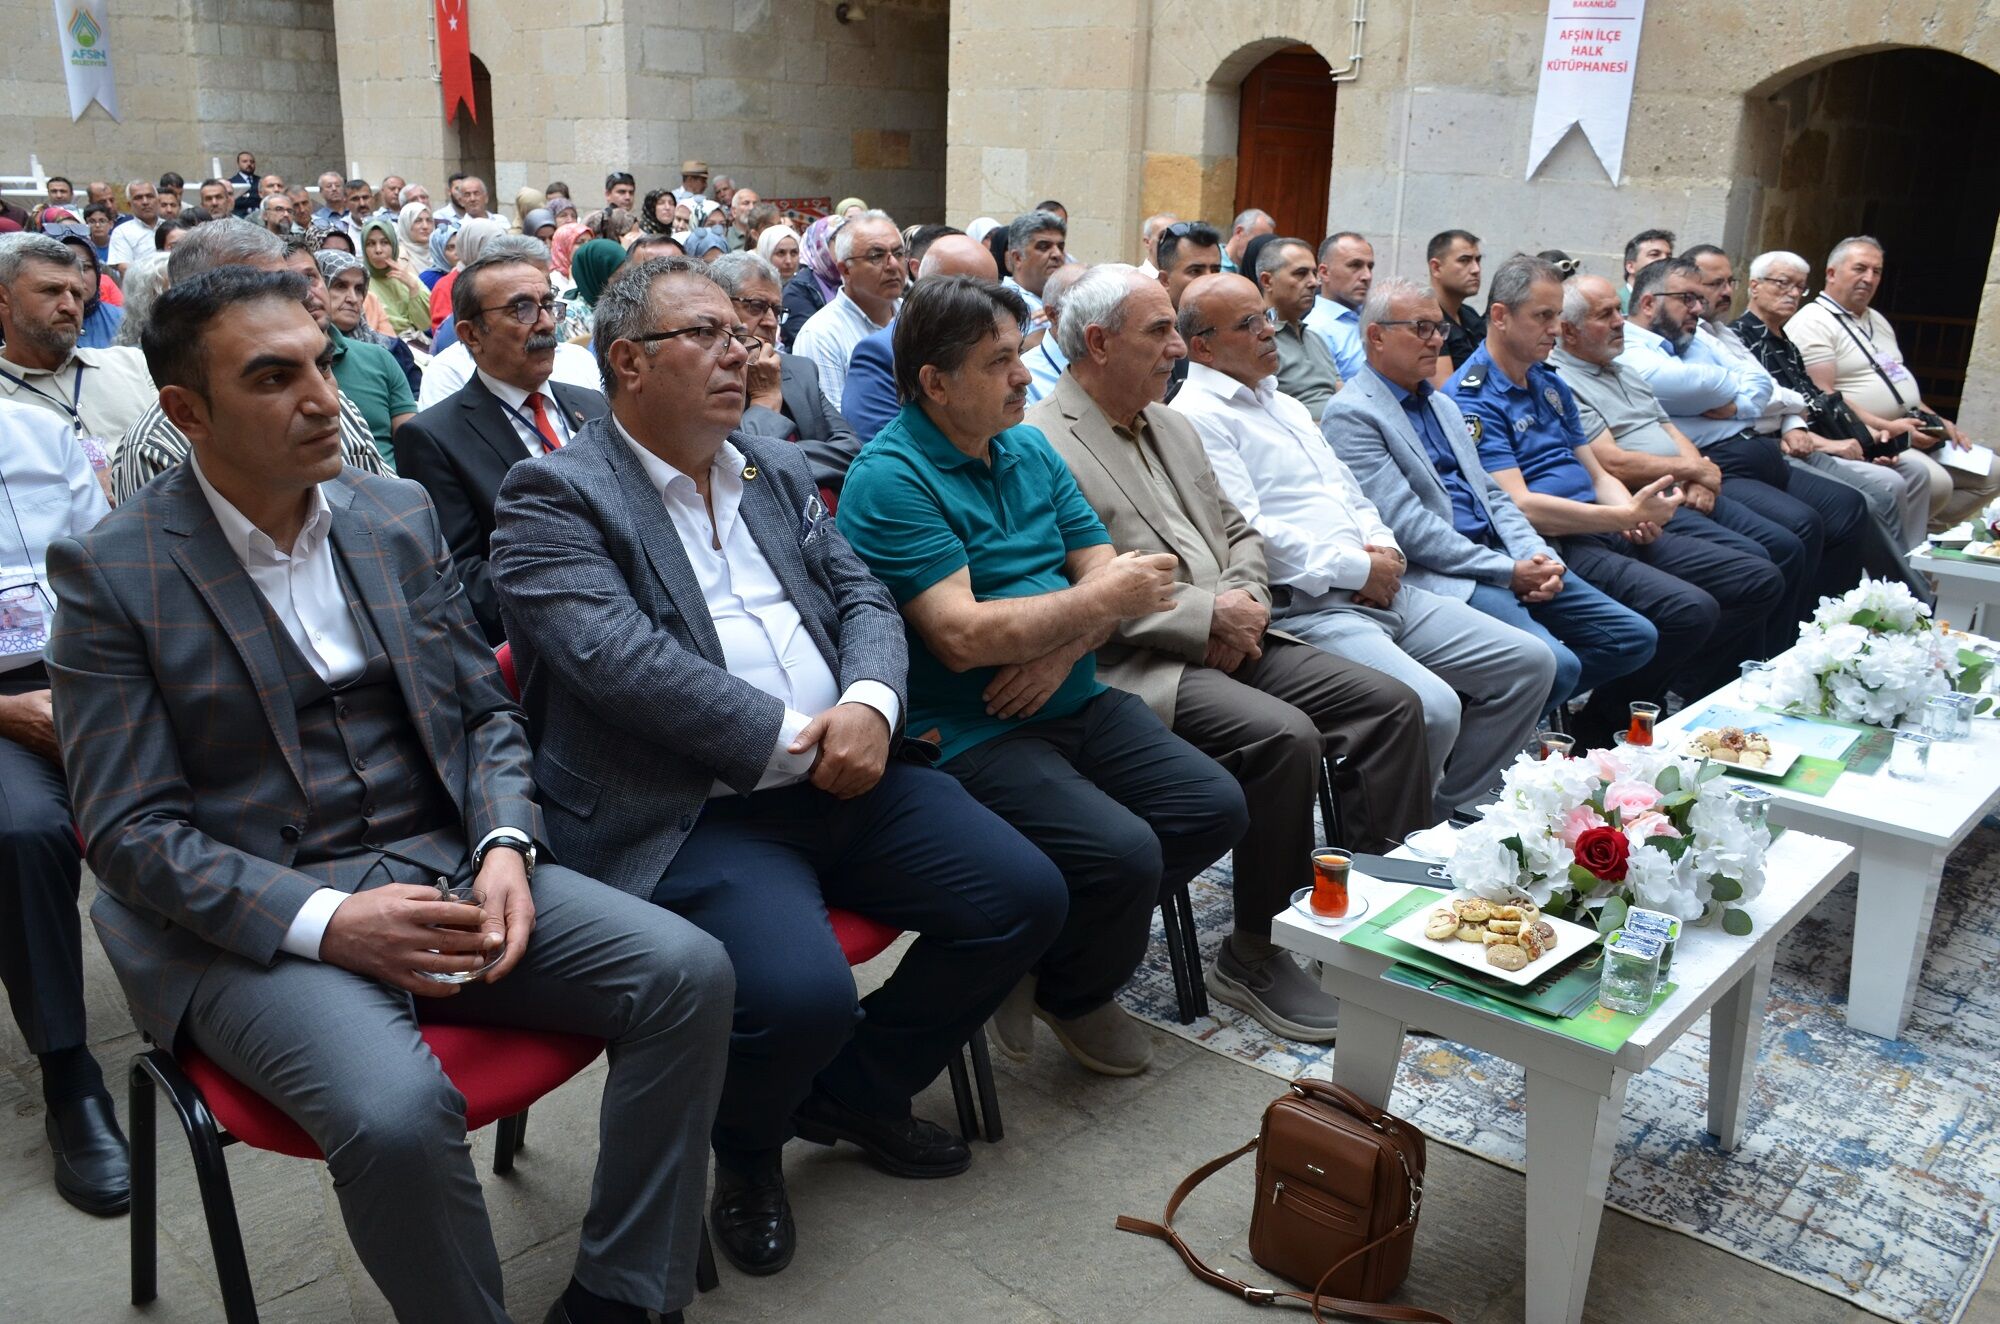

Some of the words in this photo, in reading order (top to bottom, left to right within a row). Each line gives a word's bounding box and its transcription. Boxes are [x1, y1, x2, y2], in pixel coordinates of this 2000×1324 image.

[1560, 29, 1593, 42] AFŞİN
[1596, 28, 1622, 43] İLÇE
[1571, 46, 1604, 56] HALK
[1546, 59, 1628, 73] KÜTÜPHANESİ
